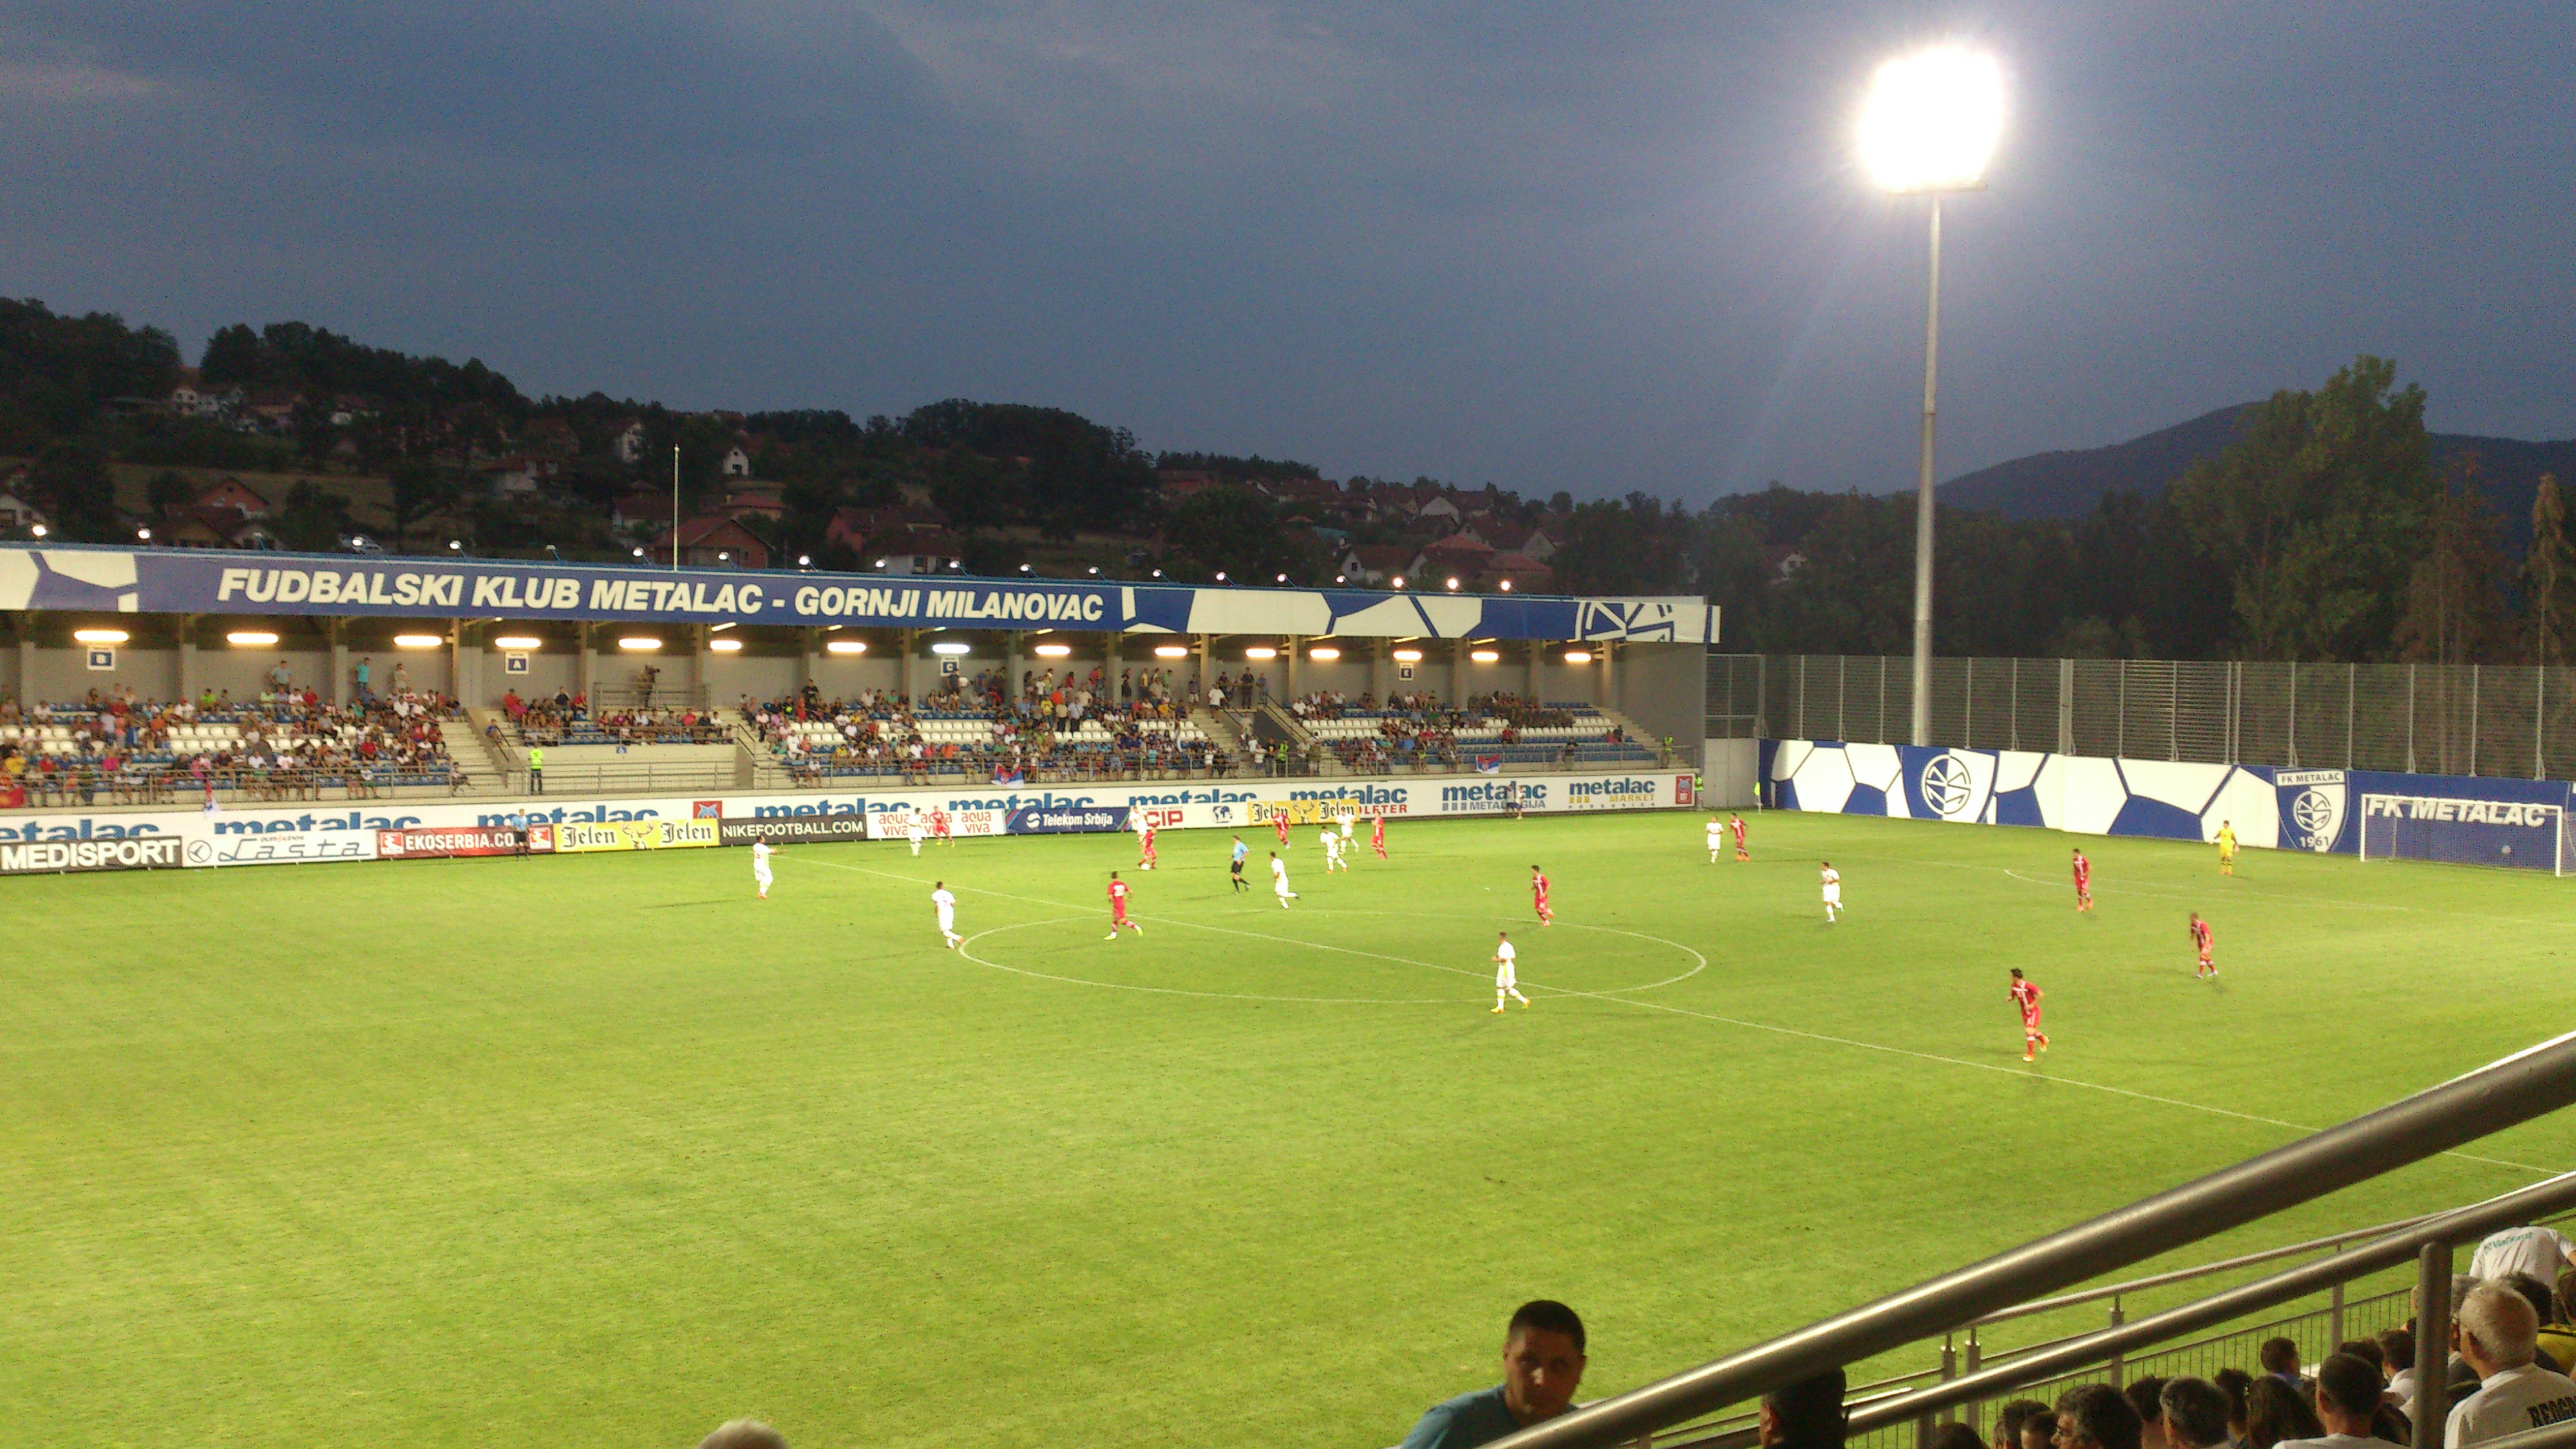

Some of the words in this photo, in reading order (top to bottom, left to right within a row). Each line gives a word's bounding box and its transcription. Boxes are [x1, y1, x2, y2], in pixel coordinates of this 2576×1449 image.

[217, 568, 465, 607] FUDBALSKI
[471, 576, 580, 609] KLUB
[589, 579, 762, 614] METALAC
[772, 599, 785, 608] -
[795, 585, 921, 618] GORNJI
[925, 590, 1104, 621] MILANOVAC
[513, 659, 522, 669] A
[946, 663, 954, 672] C
[1569, 777, 1656, 795] metalac
[2296, 773, 2340, 782] METALAC
[1129, 789, 1257, 805] metalac
[1291, 785, 1408, 804] metalac
[1443, 781, 1548, 801] metalac
[1609, 793, 1655, 802] MARKET
[755, 798, 911, 819] metalac
[949, 793, 1095, 811] metalac
[1320, 801, 1355, 820] Jeln
[1470, 800, 1546, 810] METALGIJA
[477, 806, 659, 827] metalac
[1042, 814, 1083, 827] Telekom
[1084, 813, 1113, 828] Srbija
[1146, 810, 1184, 828] CIP
[1252, 803, 1289, 822] Jeln
[2367, 797, 2403, 819] FK
[2410, 797, 2546, 827] METALAC
[214, 812, 422, 835] metalac
[722, 820, 864, 838] NIKEFOOTBALL.COM
[405, 833, 515, 851] EKOSERBIA.CO
[560, 825, 616, 848] Jelen
[660, 822, 711, 845] Jelen
[2300, 836, 2329, 848] 1961
[1, 839, 180, 870] MEDISPORT
[219, 838, 370, 862] Lasta
